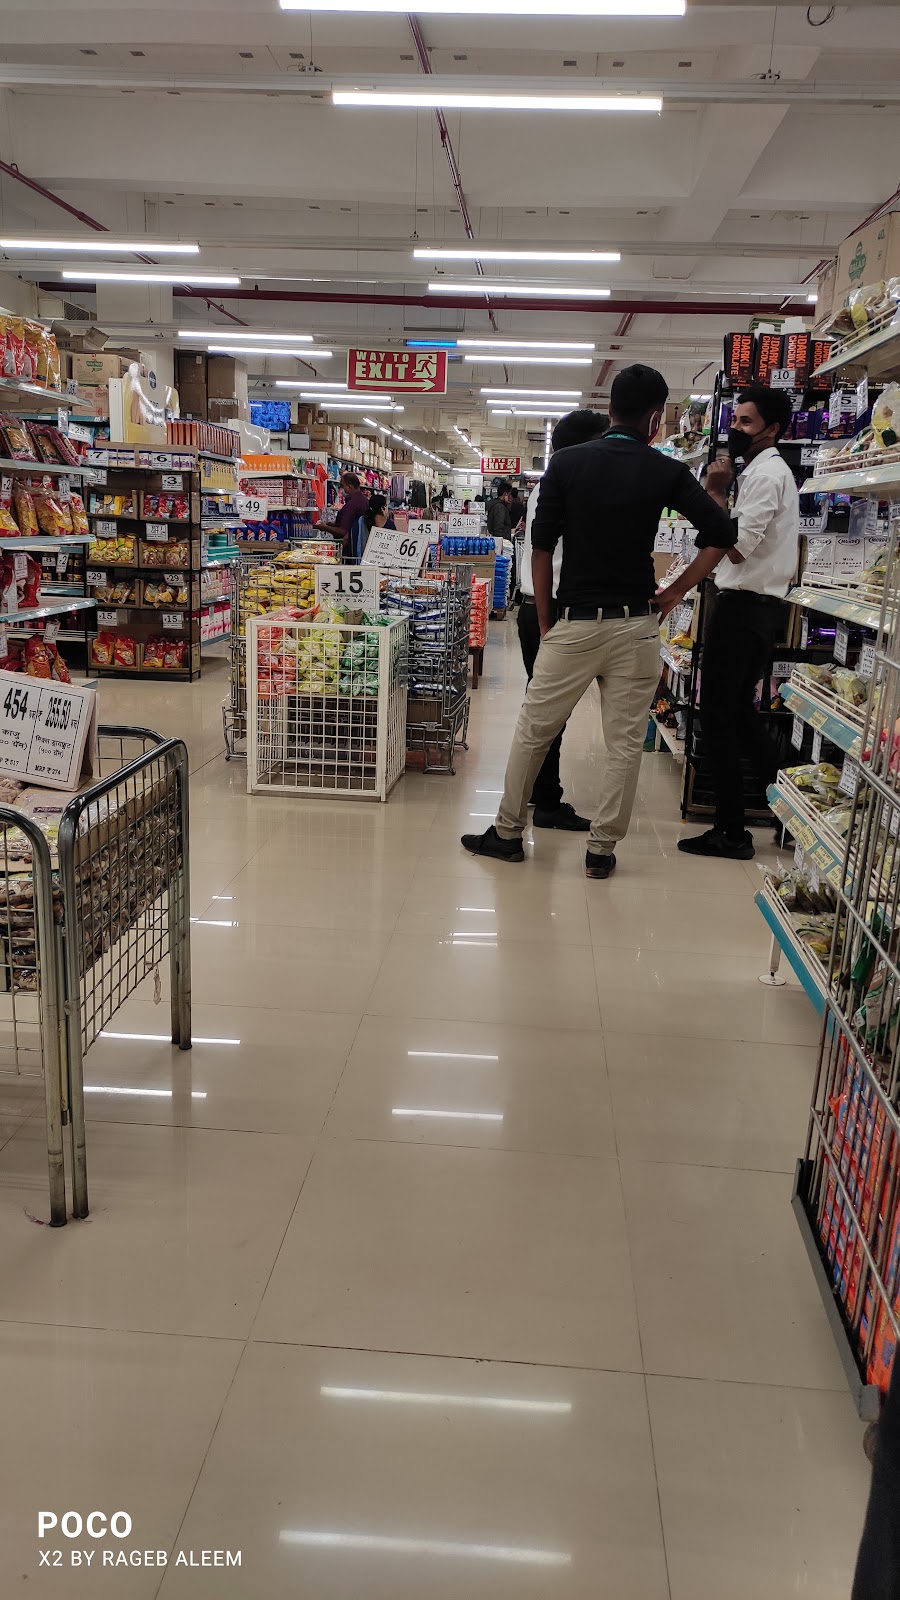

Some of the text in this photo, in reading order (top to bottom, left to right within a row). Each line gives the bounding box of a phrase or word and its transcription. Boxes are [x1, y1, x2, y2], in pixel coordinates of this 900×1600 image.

[356, 351, 410, 362] WAY TO
[731, 334, 741, 376] CHOCOLATE
[740, 339, 751, 362] DARK
[759, 336, 770, 378] CHOCOLATE
[768, 340, 780, 364] DARK
[796, 339, 808, 362] DARK
[356, 362, 408, 379] EXIT
[4, 688, 28, 720] 454
[45, 697, 71, 730] 255.50
